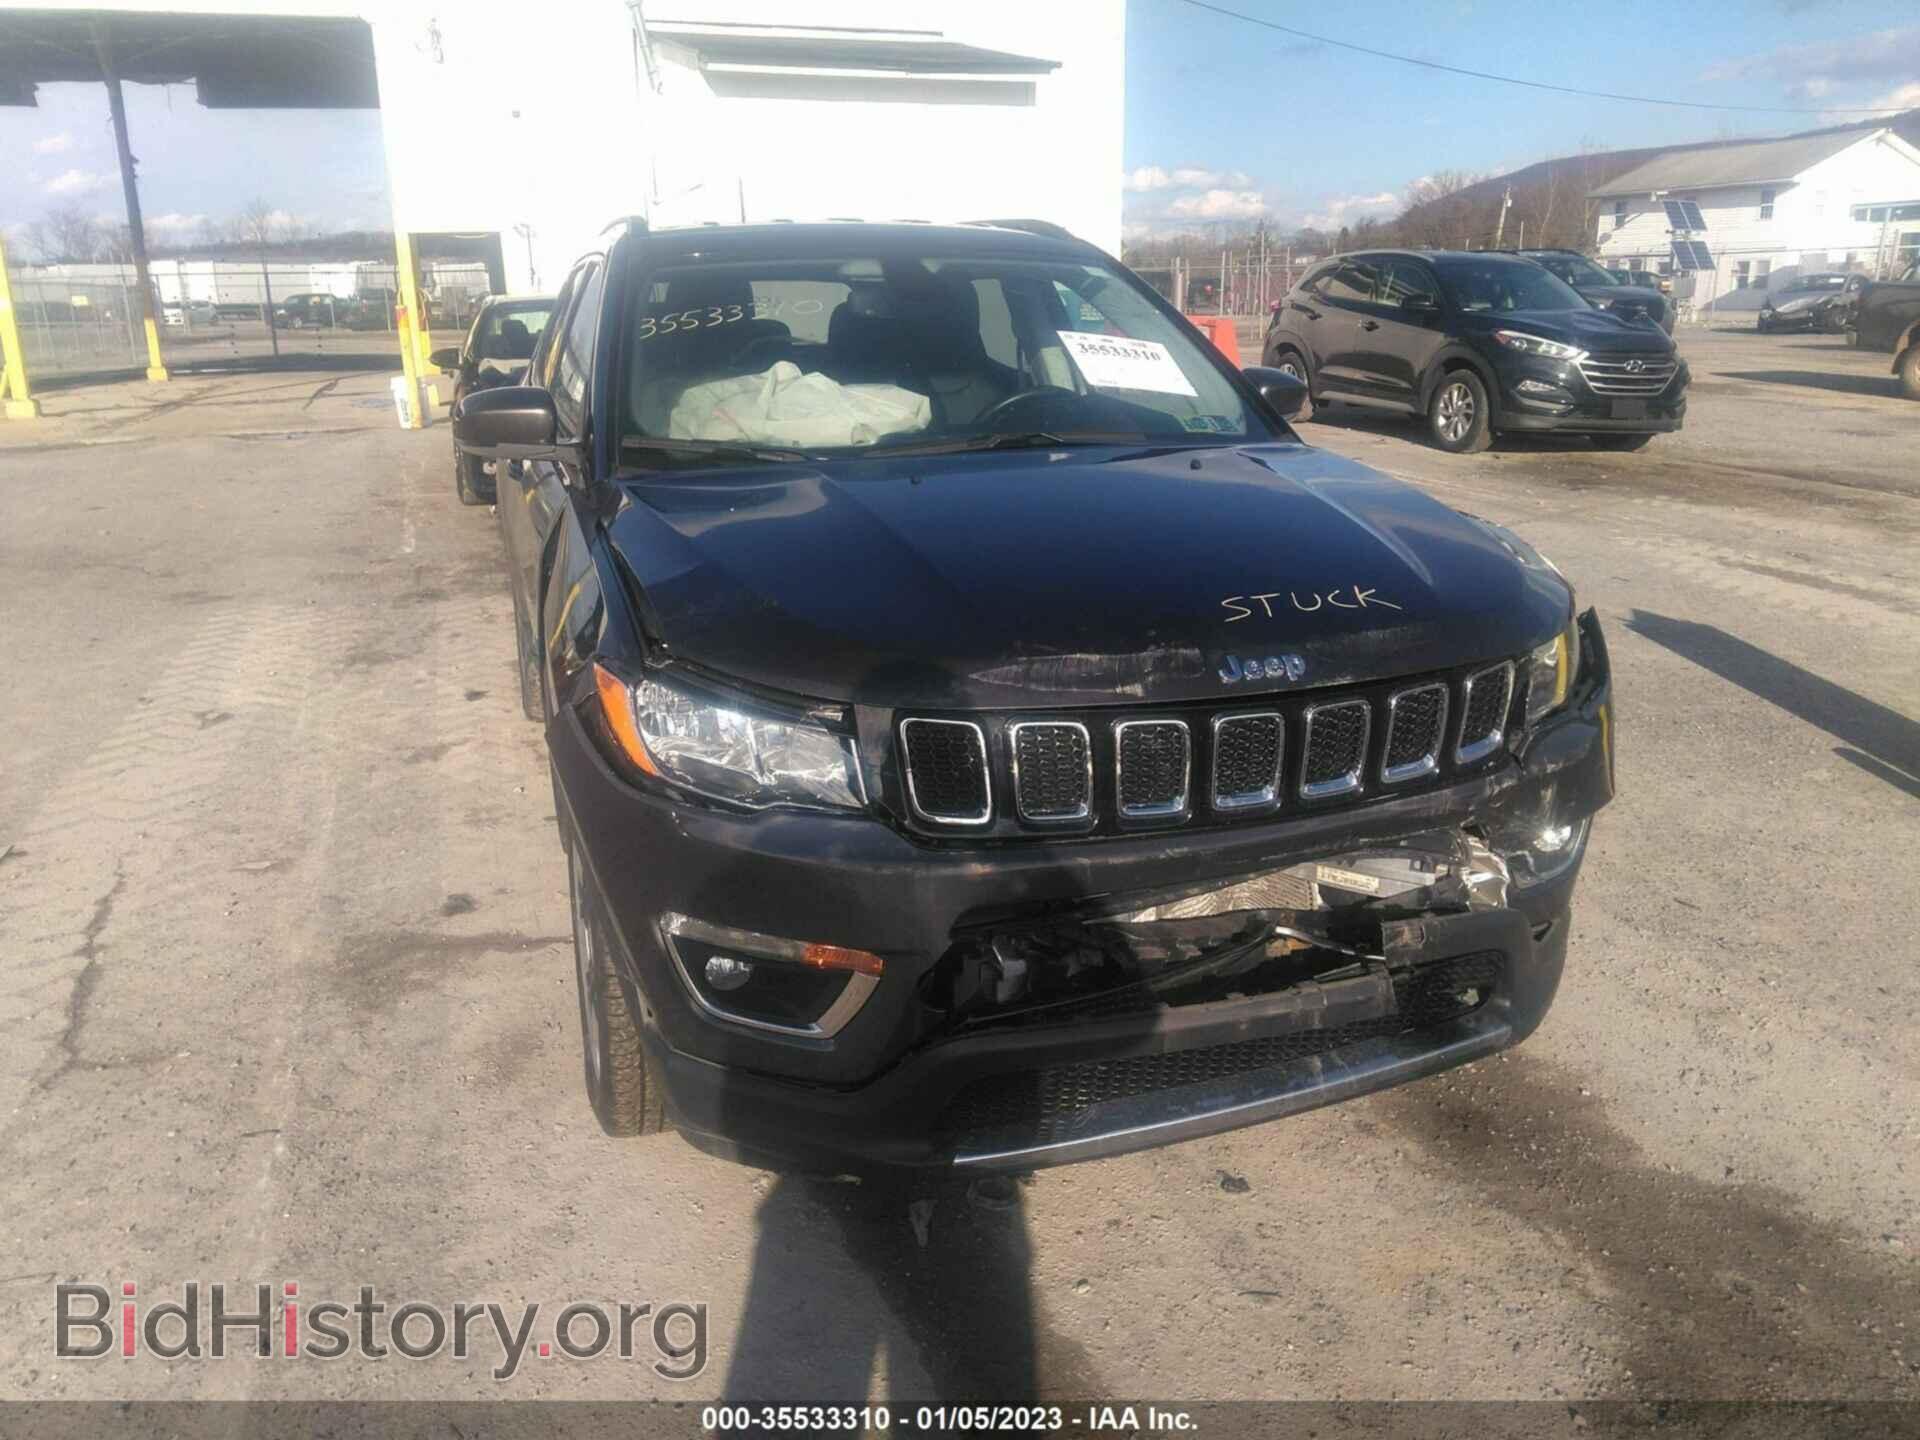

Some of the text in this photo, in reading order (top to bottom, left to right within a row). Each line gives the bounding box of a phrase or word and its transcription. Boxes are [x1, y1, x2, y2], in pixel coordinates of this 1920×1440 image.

[639, 299, 824, 340] 35533310
[1077, 343, 1161, 361] 35533310
[1221, 585, 1403, 623] STUCK
[1217, 653, 1307, 685] Jeep
